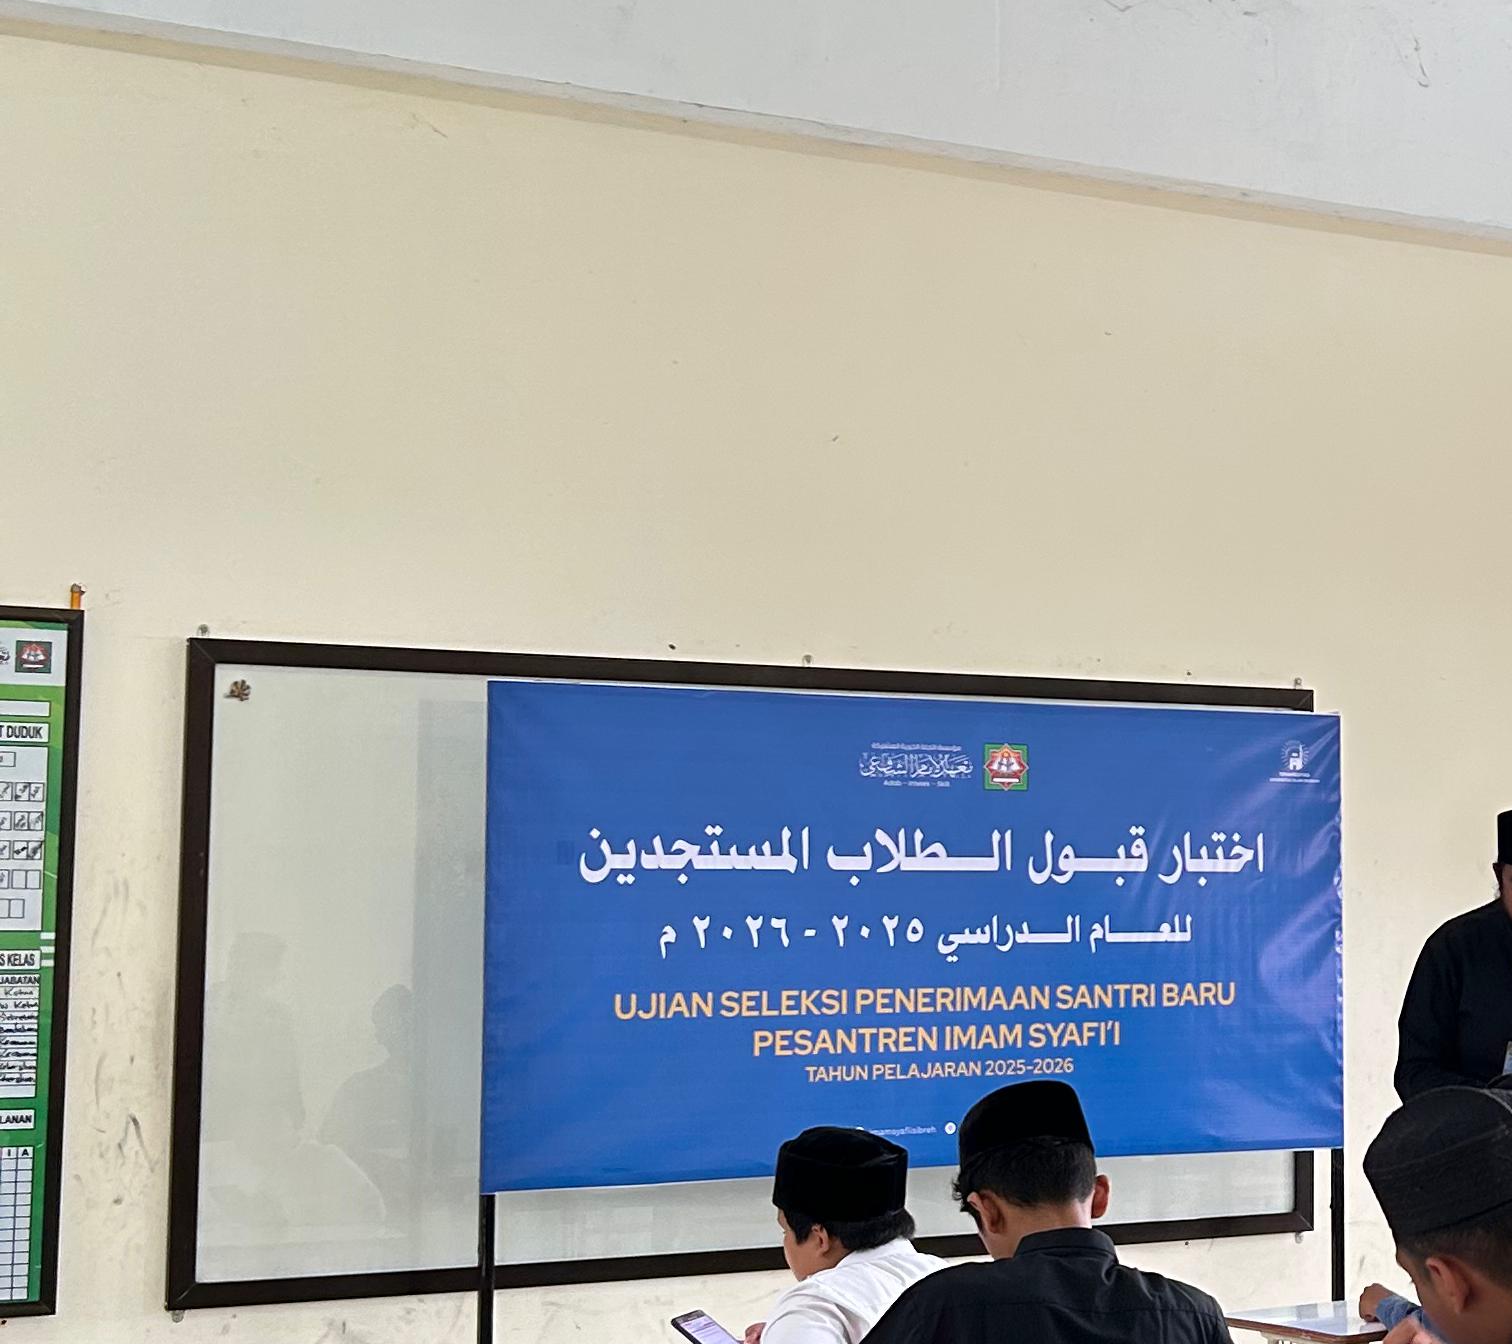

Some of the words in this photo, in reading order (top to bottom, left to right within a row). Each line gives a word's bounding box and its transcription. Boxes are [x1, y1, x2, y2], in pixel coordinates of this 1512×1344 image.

[6, 725, 43, 739] DUDUK
[579, 825, 810, 885] المستجدين
[827, 827, 1012, 887] الطلاب
[1028, 825, 1149, 887] قبول
[1158, 831, 1264, 887] اختبار
[659, 924, 678, 960] م
[692, 914, 791, 949] ٢٠٢٦
[831, 914, 925, 948] ٢٠٢٥
[937, 914, 1081, 963] الدراسي
[1089, 914, 1192, 954] للعام
[7, 952, 36, 967] KELAS
[613, 992, 714, 1020] UJIAN
[719, 989, 848, 1017] SELEKSI
[854, 985, 1050, 1014] PENERIMAAN
[1055, 983, 1156, 1010] SANTRI
[1161, 981, 1236, 1008] BARU
[753, 1025, 938, 1057] PESANTREN
[943, 1023, 1023, 1052] IMAM
[805, 1064, 868, 1083] TAHUN
[872, 1060, 982, 1081] PELAJARAN
[984, 1057, 1075, 1077] 2025-2026
